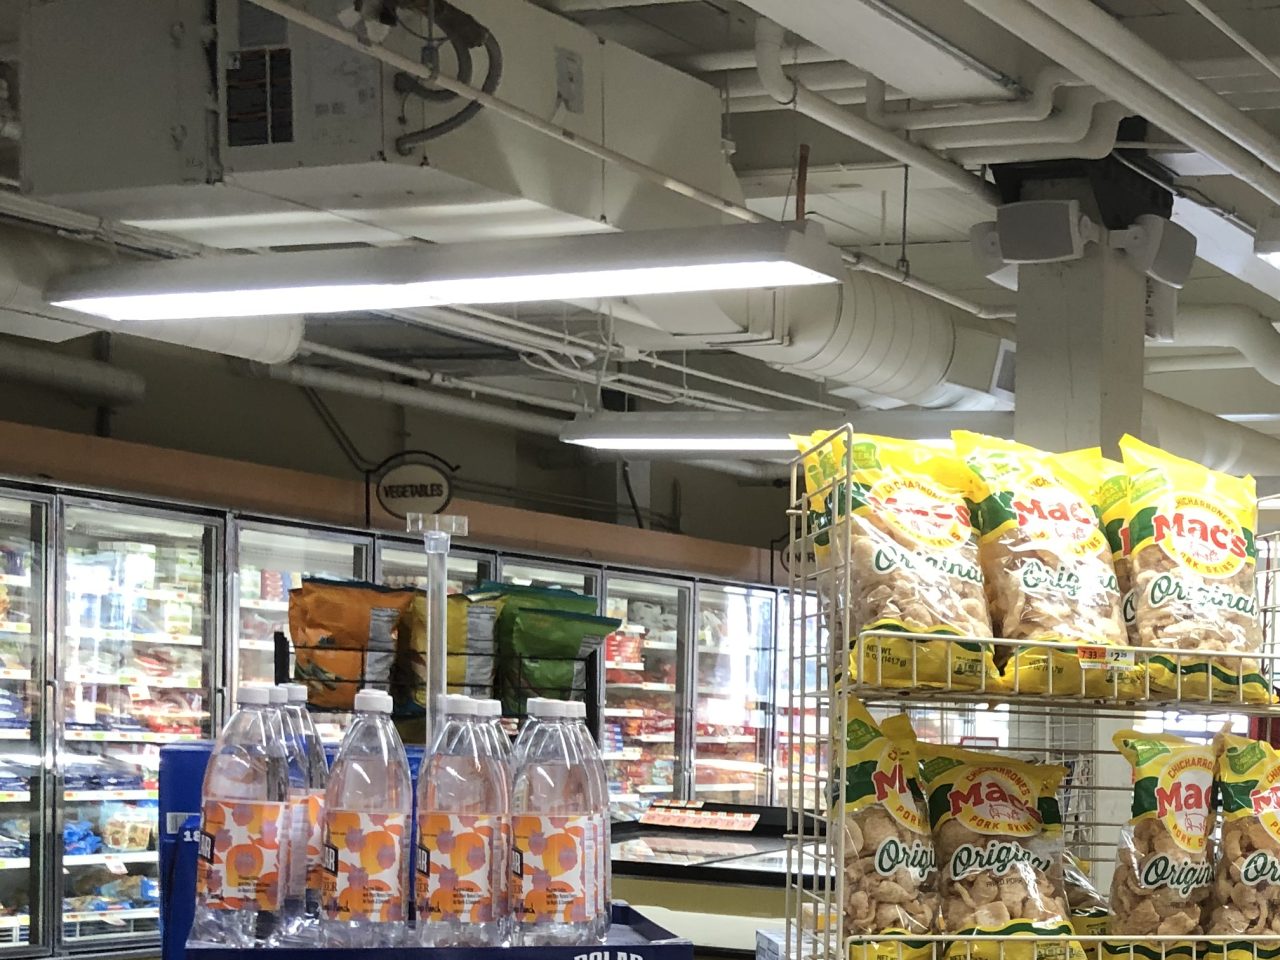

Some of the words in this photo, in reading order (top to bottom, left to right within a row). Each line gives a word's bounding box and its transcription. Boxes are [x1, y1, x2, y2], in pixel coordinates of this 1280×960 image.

[1153, 512, 1247, 559] Mac's
[1167, 757, 1215, 780] CHICHARRO
[948, 782, 1043, 825] Mac's
[969, 814, 1000, 830] PORK
